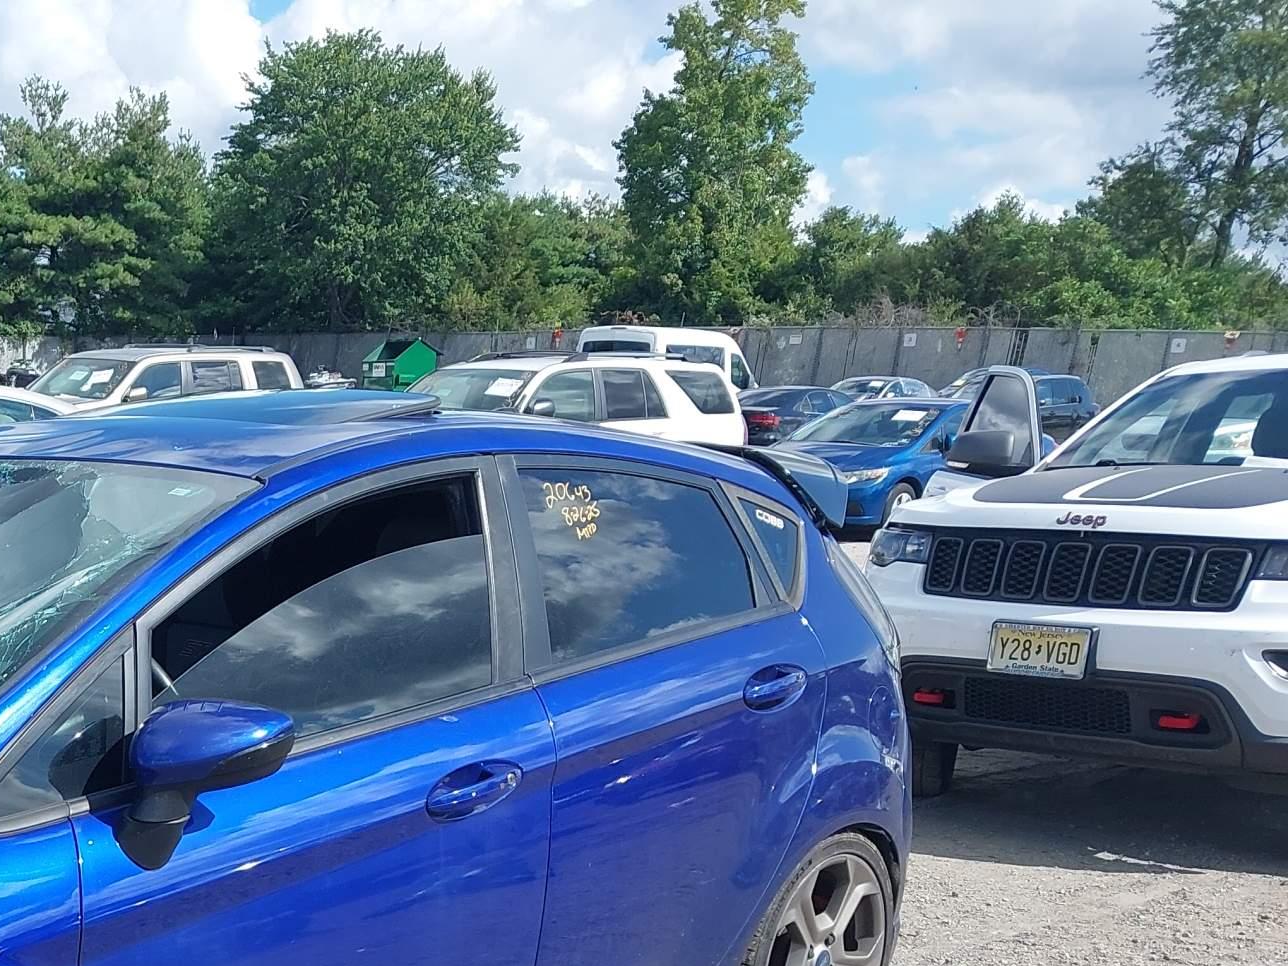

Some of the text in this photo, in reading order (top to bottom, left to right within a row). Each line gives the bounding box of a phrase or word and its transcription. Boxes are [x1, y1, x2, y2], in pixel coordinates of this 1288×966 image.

[543, 482, 592, 508] 20643
[1055, 511, 1107, 529] Jeep
[1017, 629, 1064, 640] New Jersey
[1000, 636, 1081, 666] Y28 VGD
[1011, 662, 1059, 673] Garden State
